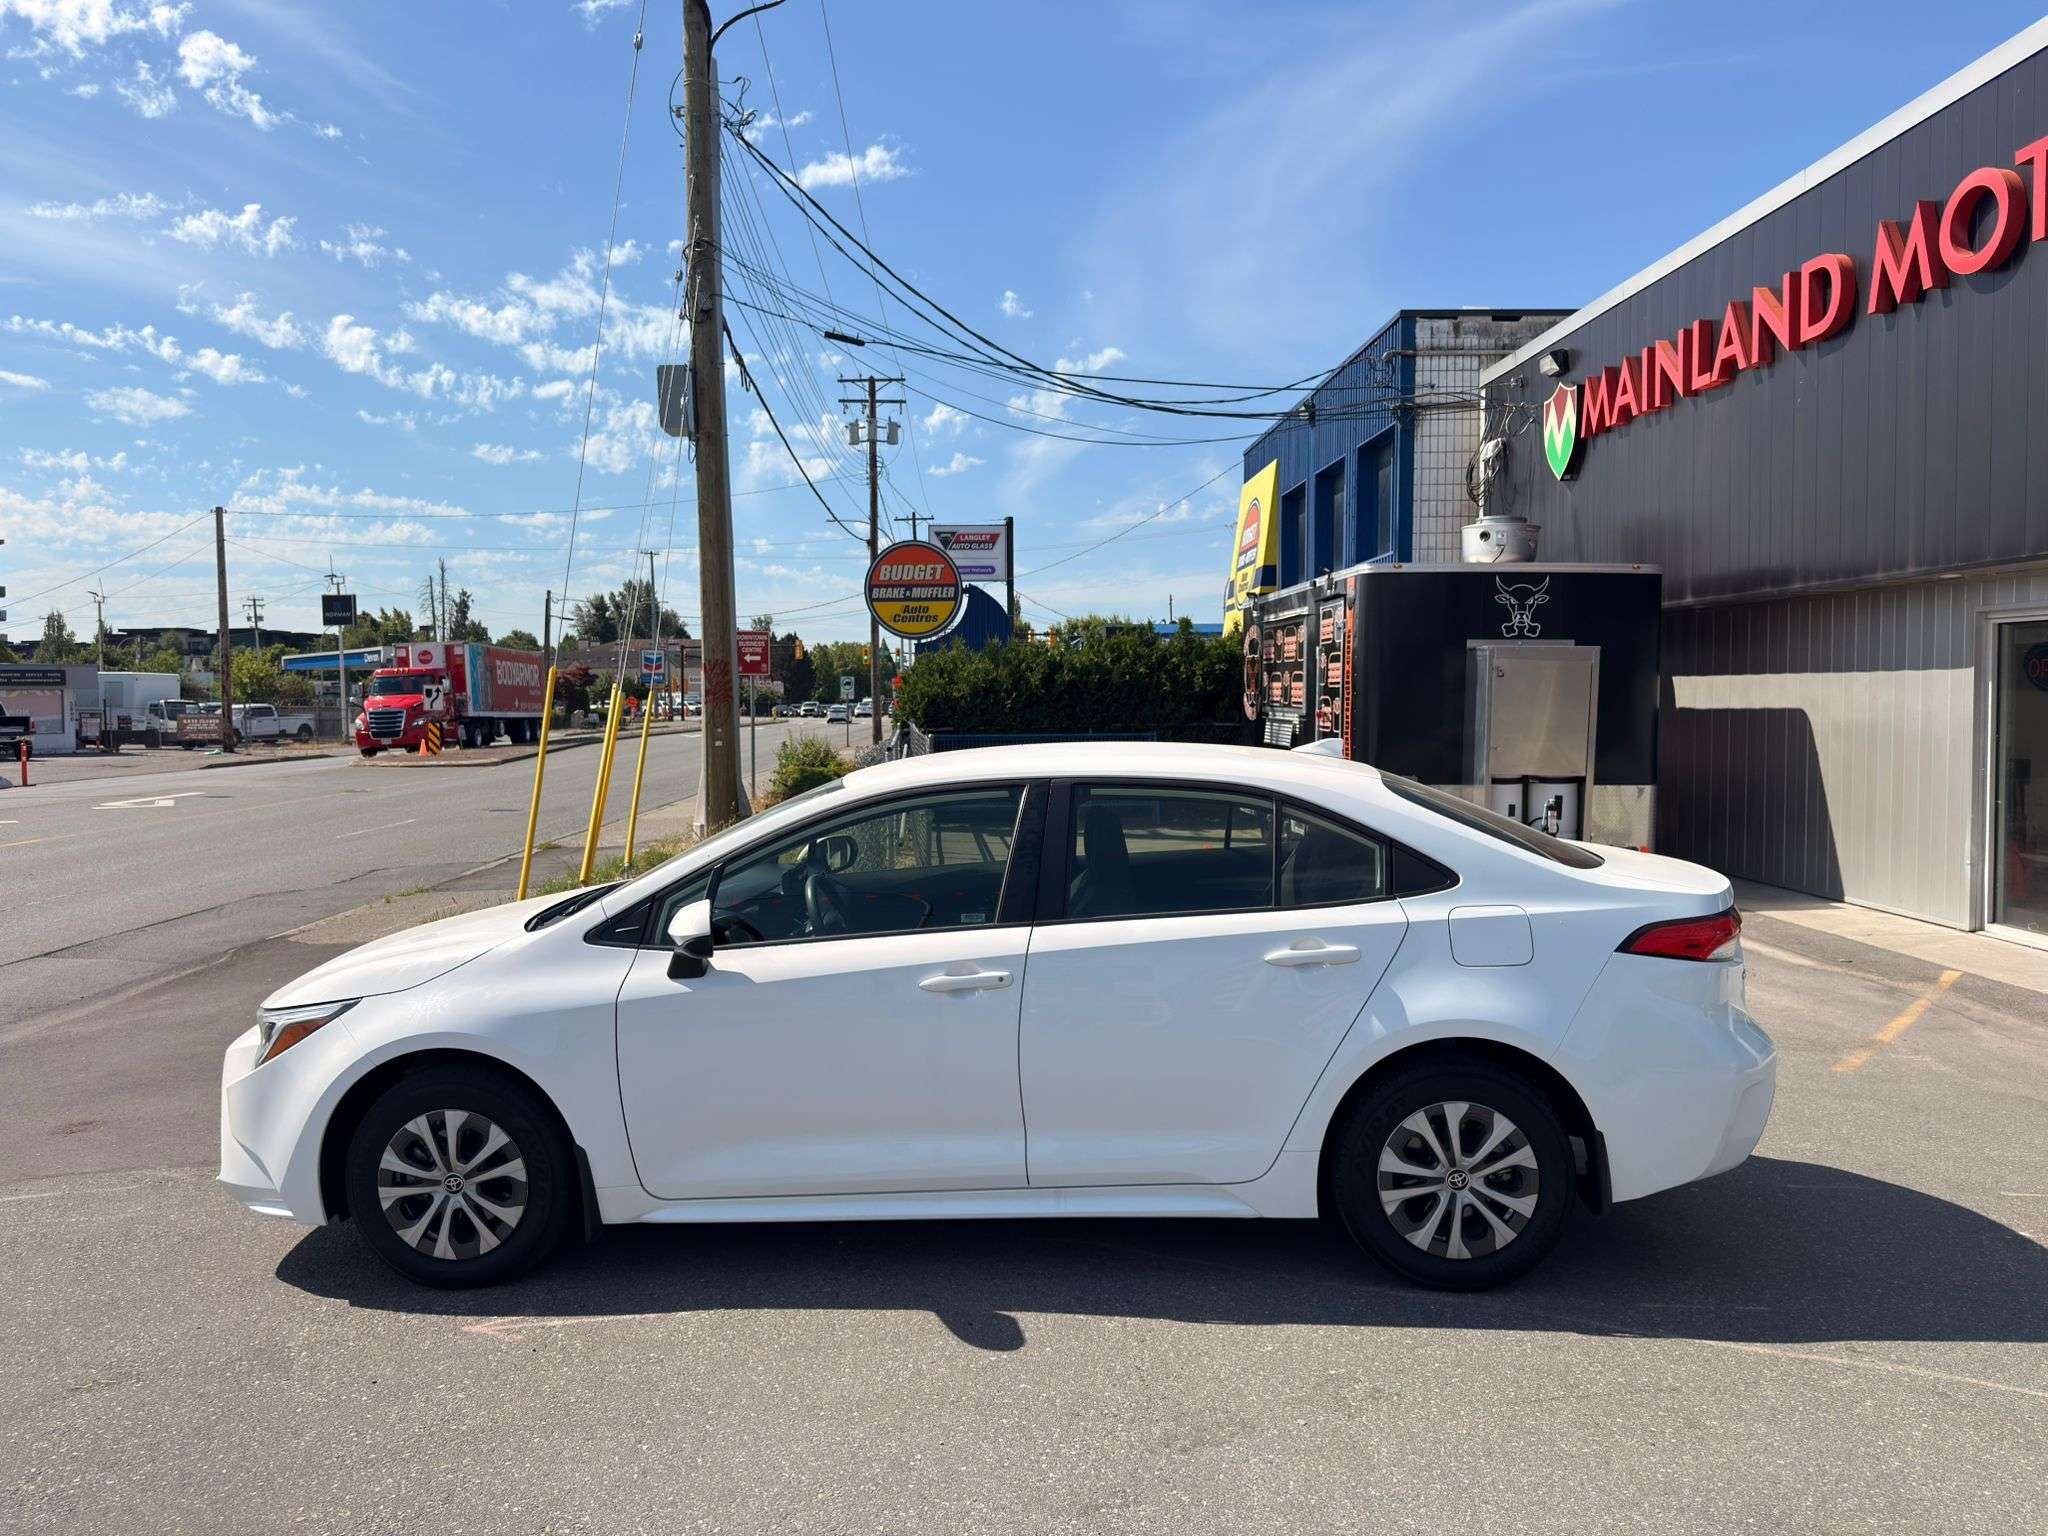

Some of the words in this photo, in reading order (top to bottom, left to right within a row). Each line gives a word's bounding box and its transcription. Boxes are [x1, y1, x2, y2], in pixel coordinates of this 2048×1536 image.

[1581, 253, 1856, 438] MAINLAND
[879, 564, 944, 581] BUDGET
[872, 588, 905, 598] BRAKE
[911, 587, 955, 598] MUFFLER
[903, 605, 929, 614] Auto
[893, 614, 938, 623] Centres
[496, 660, 541, 688] BODYARMOR
